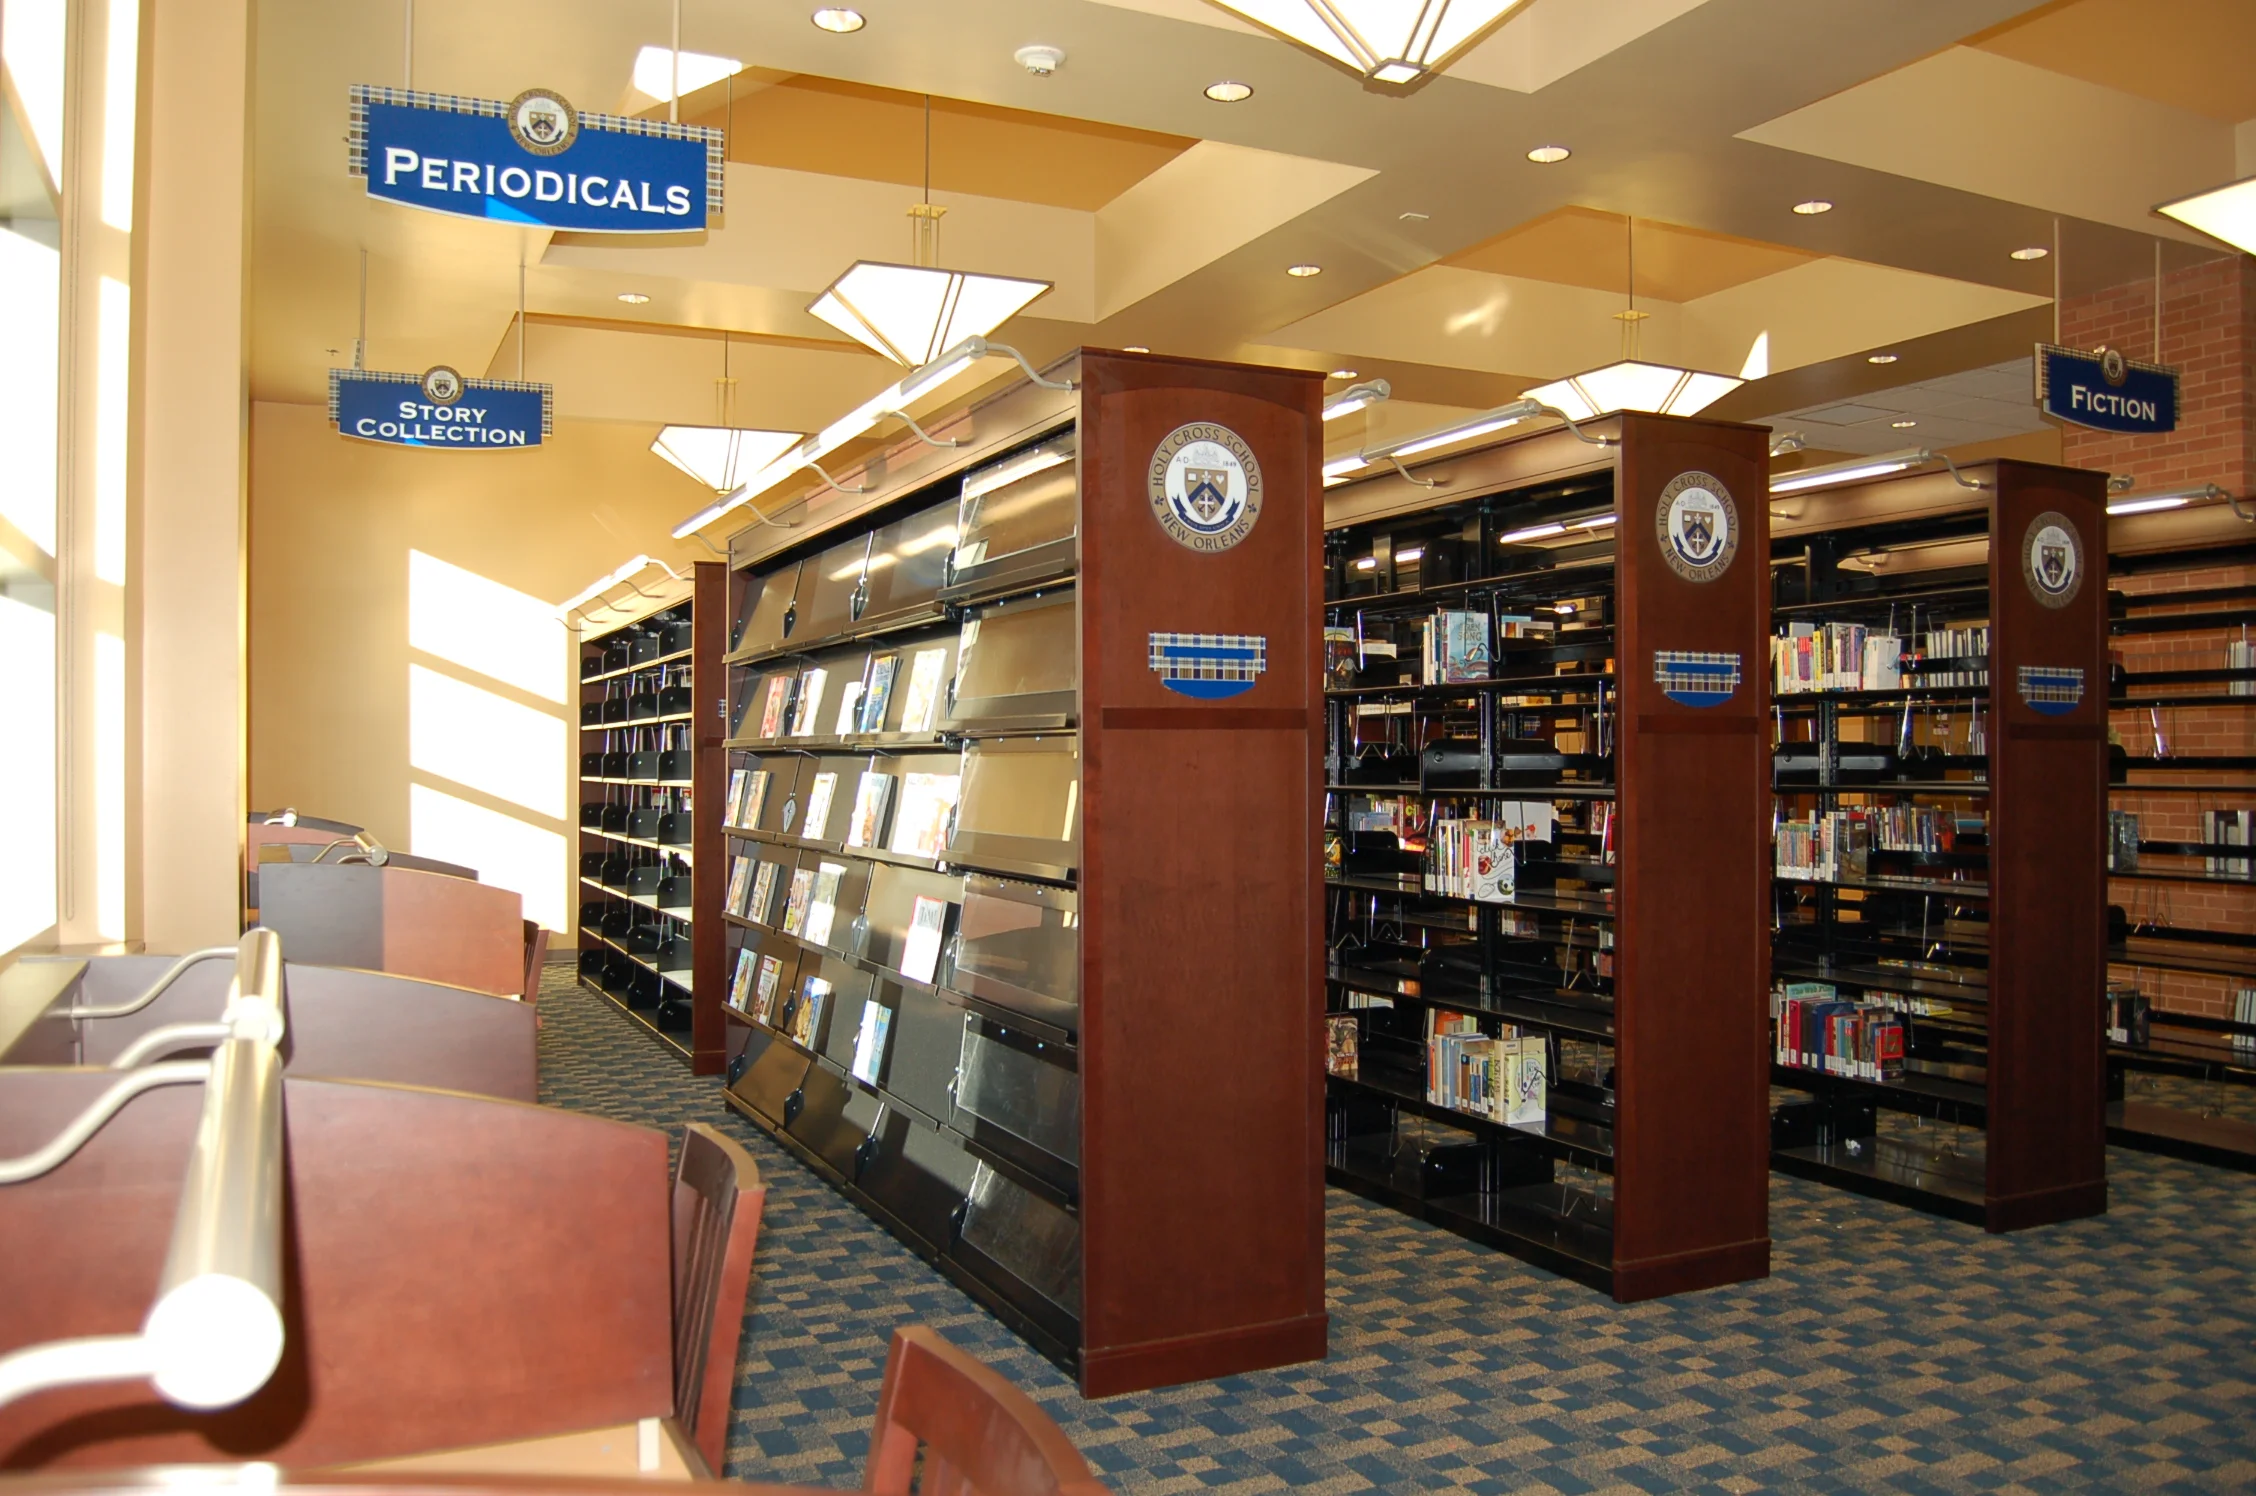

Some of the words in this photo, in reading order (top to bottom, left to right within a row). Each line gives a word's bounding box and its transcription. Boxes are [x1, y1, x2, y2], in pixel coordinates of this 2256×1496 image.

[384, 147, 691, 216] PERIODICALS
[399, 401, 487, 424] STORY
[2071, 384, 2156, 422] FICTION
[356, 418, 526, 445] COLLECTION
[1152, 445, 1172, 486] HOLY
[1173, 427, 1220, 446] CROSS
[1224, 434, 1260, 495] SCHOOL
[1658, 490, 1674, 526] HOLY
[1673, 475, 1708, 492] CROSS
[1711, 482, 1736, 532] SCHOOL
[1161, 512, 1190, 542] NEW
[1193, 518, 1250, 550] ORLEANS
[1665, 548, 1687, 574] NEW
[1688, 556, 1730, 580] ORLEANS
